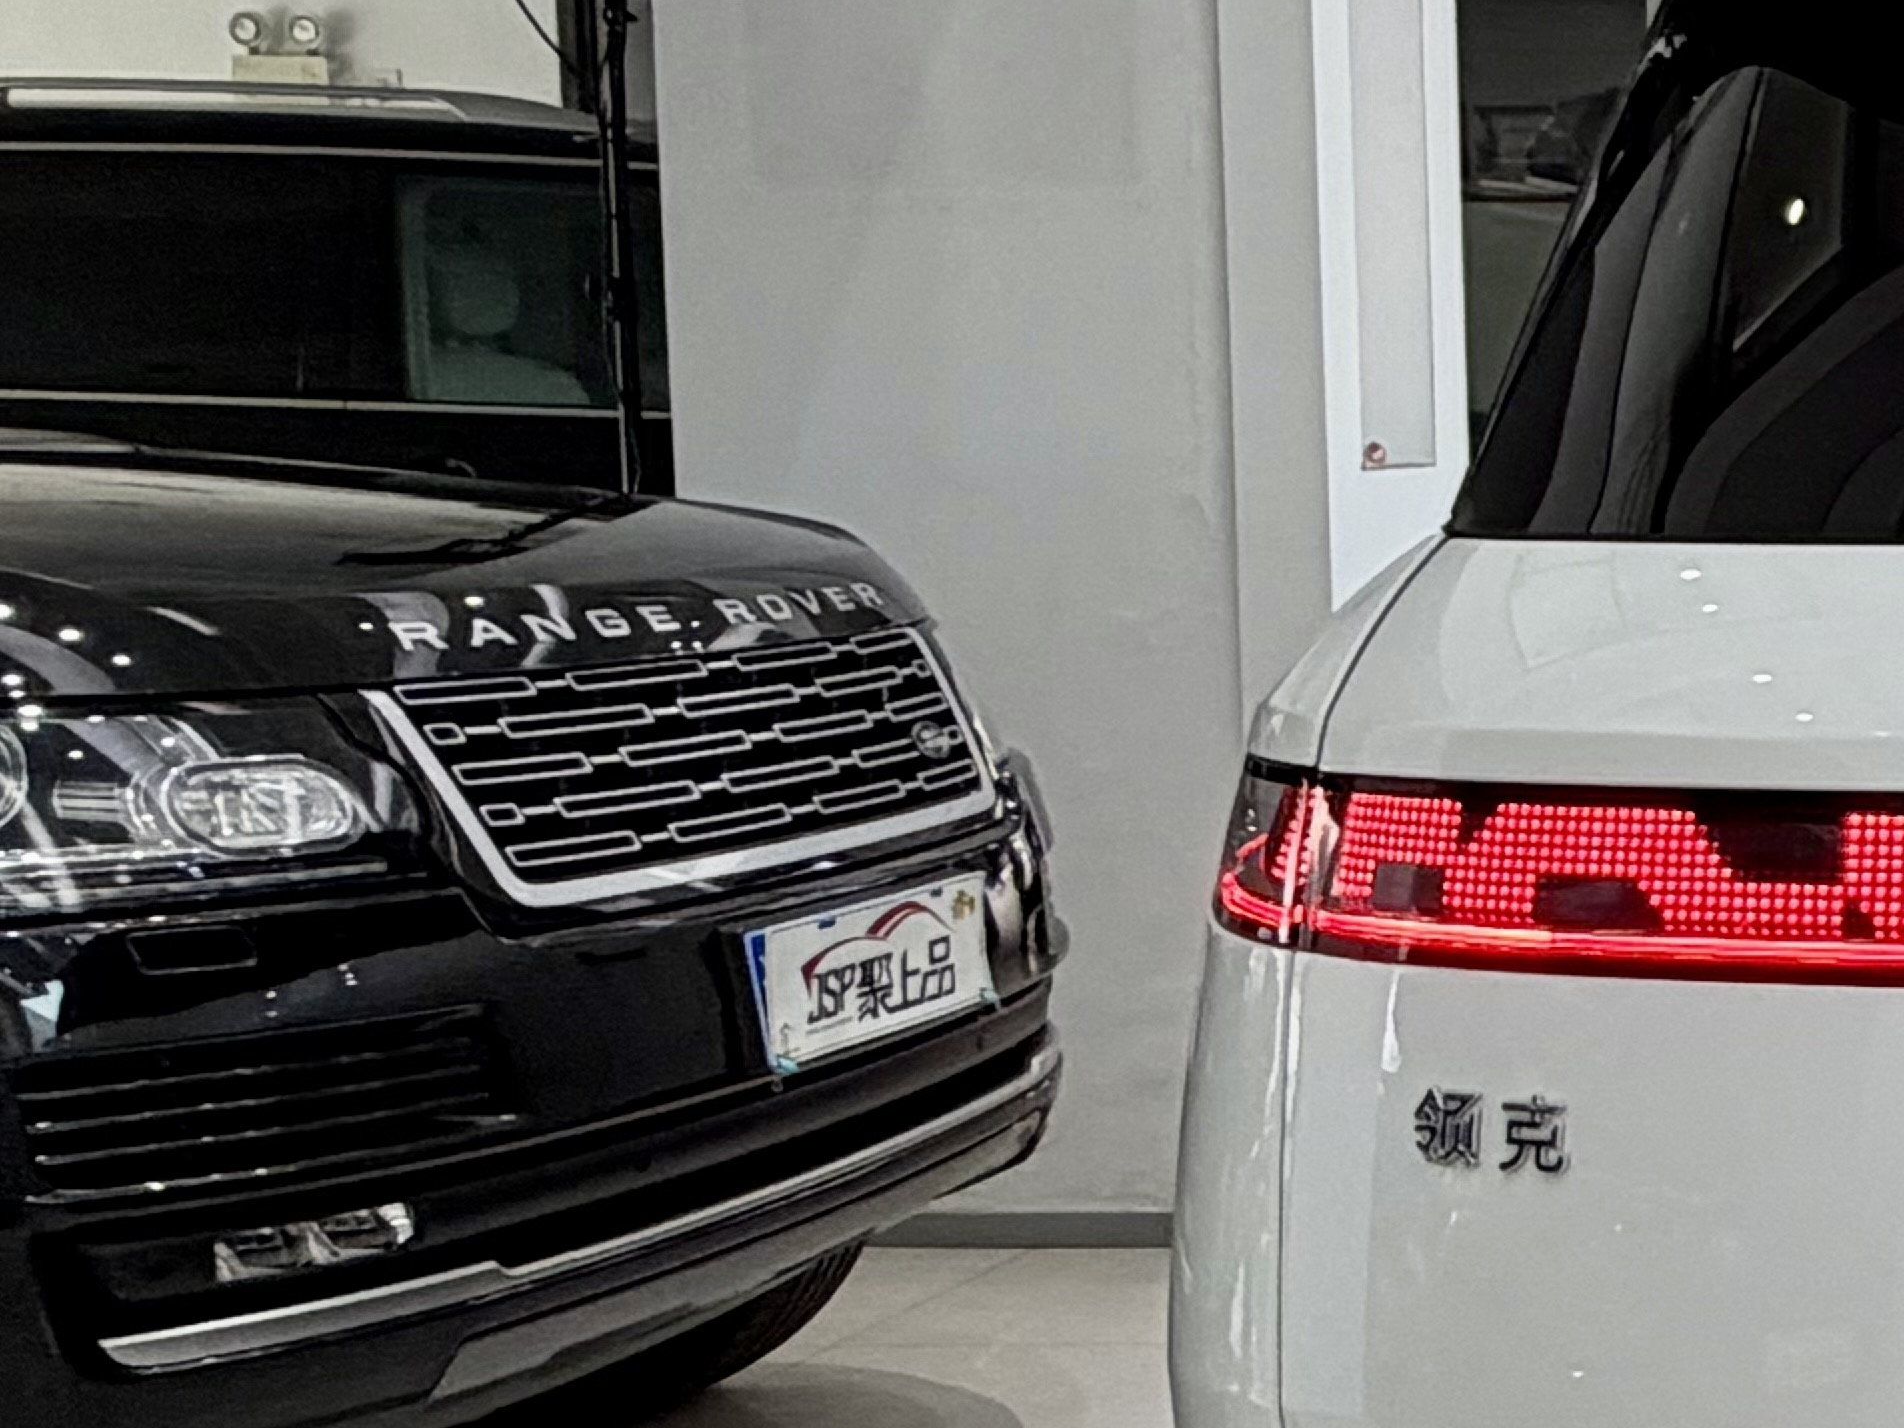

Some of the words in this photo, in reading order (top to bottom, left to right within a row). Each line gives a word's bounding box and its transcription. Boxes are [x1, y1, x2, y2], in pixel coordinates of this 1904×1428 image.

[388, 604, 682, 652] RANGE
[713, 581, 885, 627] ROVER
[1414, 1086, 1571, 1172] 领克
